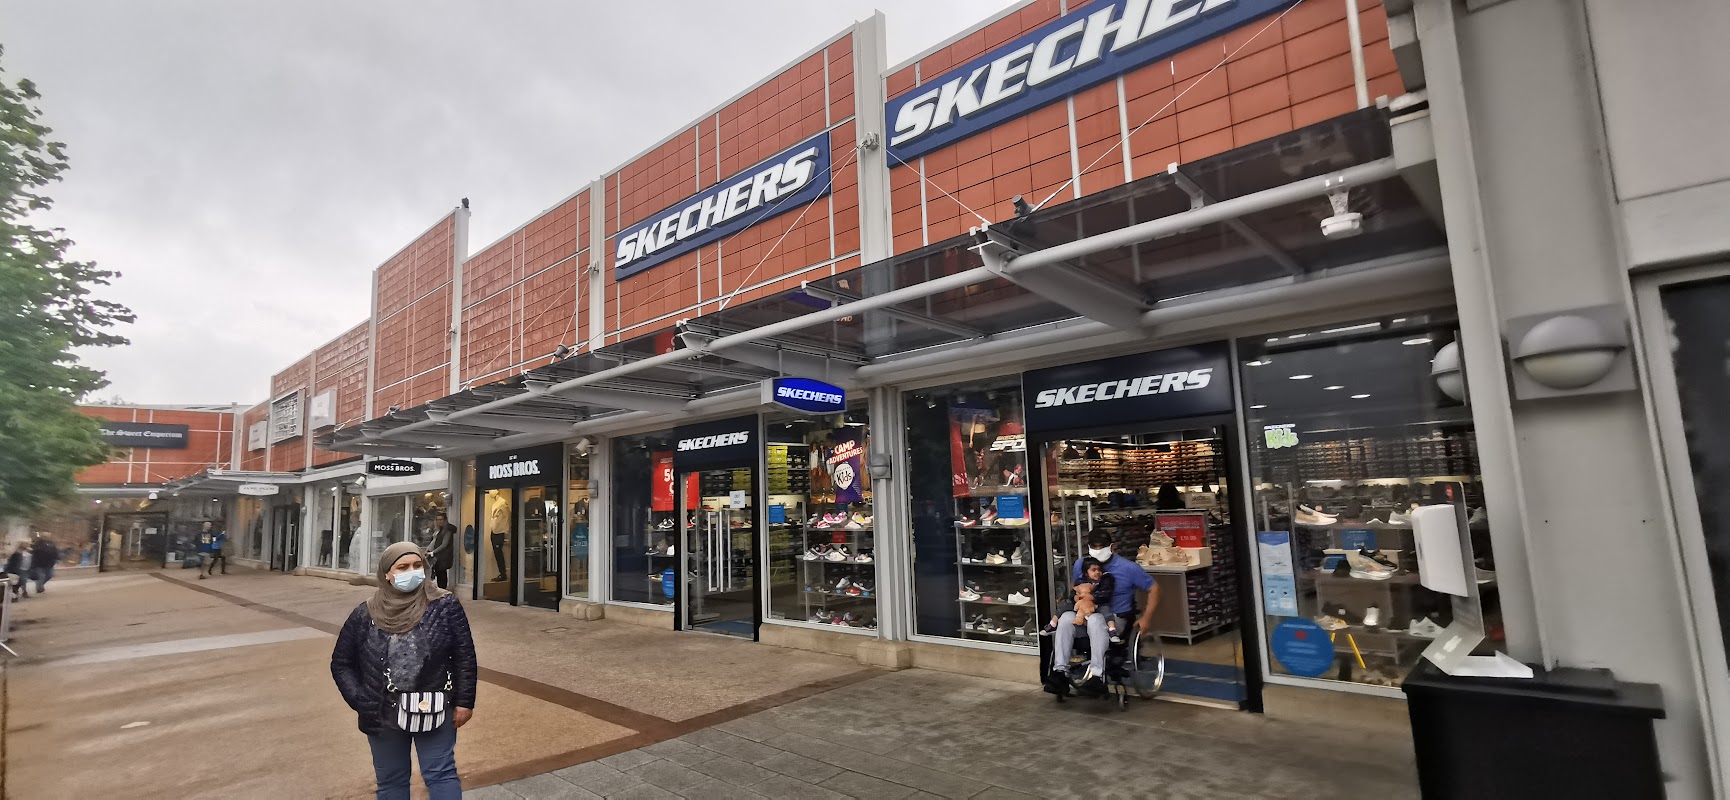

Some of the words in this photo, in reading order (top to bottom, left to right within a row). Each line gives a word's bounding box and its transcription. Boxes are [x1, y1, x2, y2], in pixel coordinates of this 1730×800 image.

[890, 0, 1232, 147] SKECHE
[614, 146, 819, 269] SKECHERS
[776, 386, 843, 405] SKECHERS
[1034, 367, 1214, 409] SKECHERS
[676, 430, 750, 452] SKECHERS
[834, 439, 856, 455] CAMP
[828, 446, 864, 465] ADVENTURES
[374, 464, 395, 472] MOSS
[489, 463, 513, 479] MOSS
[512, 459, 541, 477] BROS.
[836, 470, 853, 486] Kids
